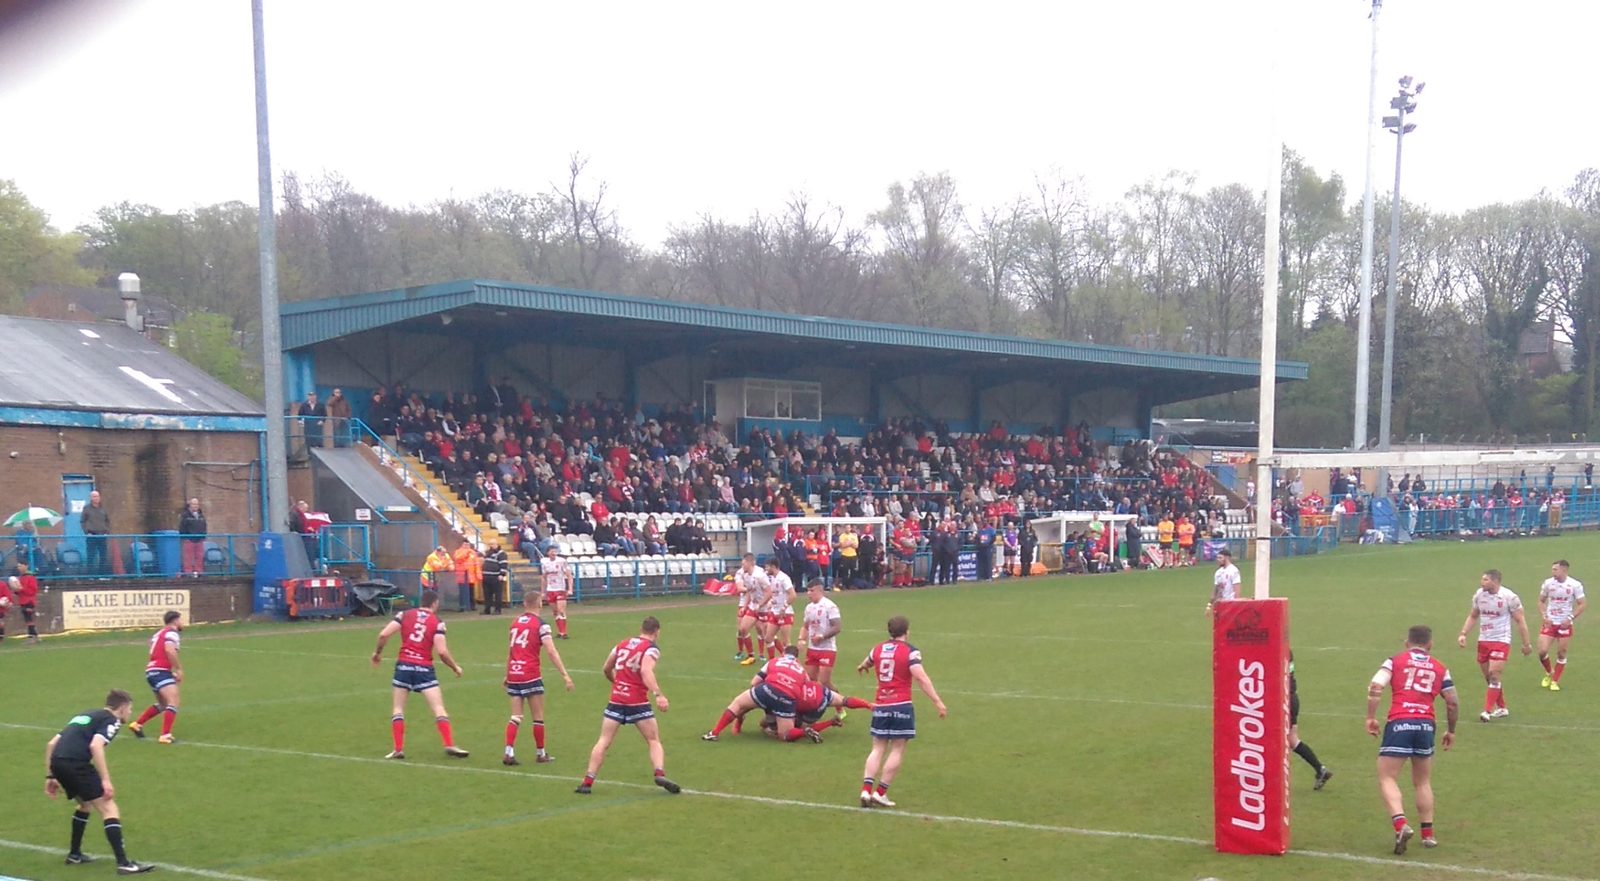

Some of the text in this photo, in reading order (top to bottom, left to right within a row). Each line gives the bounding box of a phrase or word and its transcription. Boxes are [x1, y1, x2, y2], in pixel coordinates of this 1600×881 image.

[72, 592, 184, 608] ALKIE LIMITED
[409, 622, 428, 642] 3
[510, 627, 530, 649] 14
[615, 648, 642, 673] 24
[879, 659, 896, 682] 9
[1403, 667, 1436, 693] 13
[1230, 658, 1266, 831] Ladbrokes
